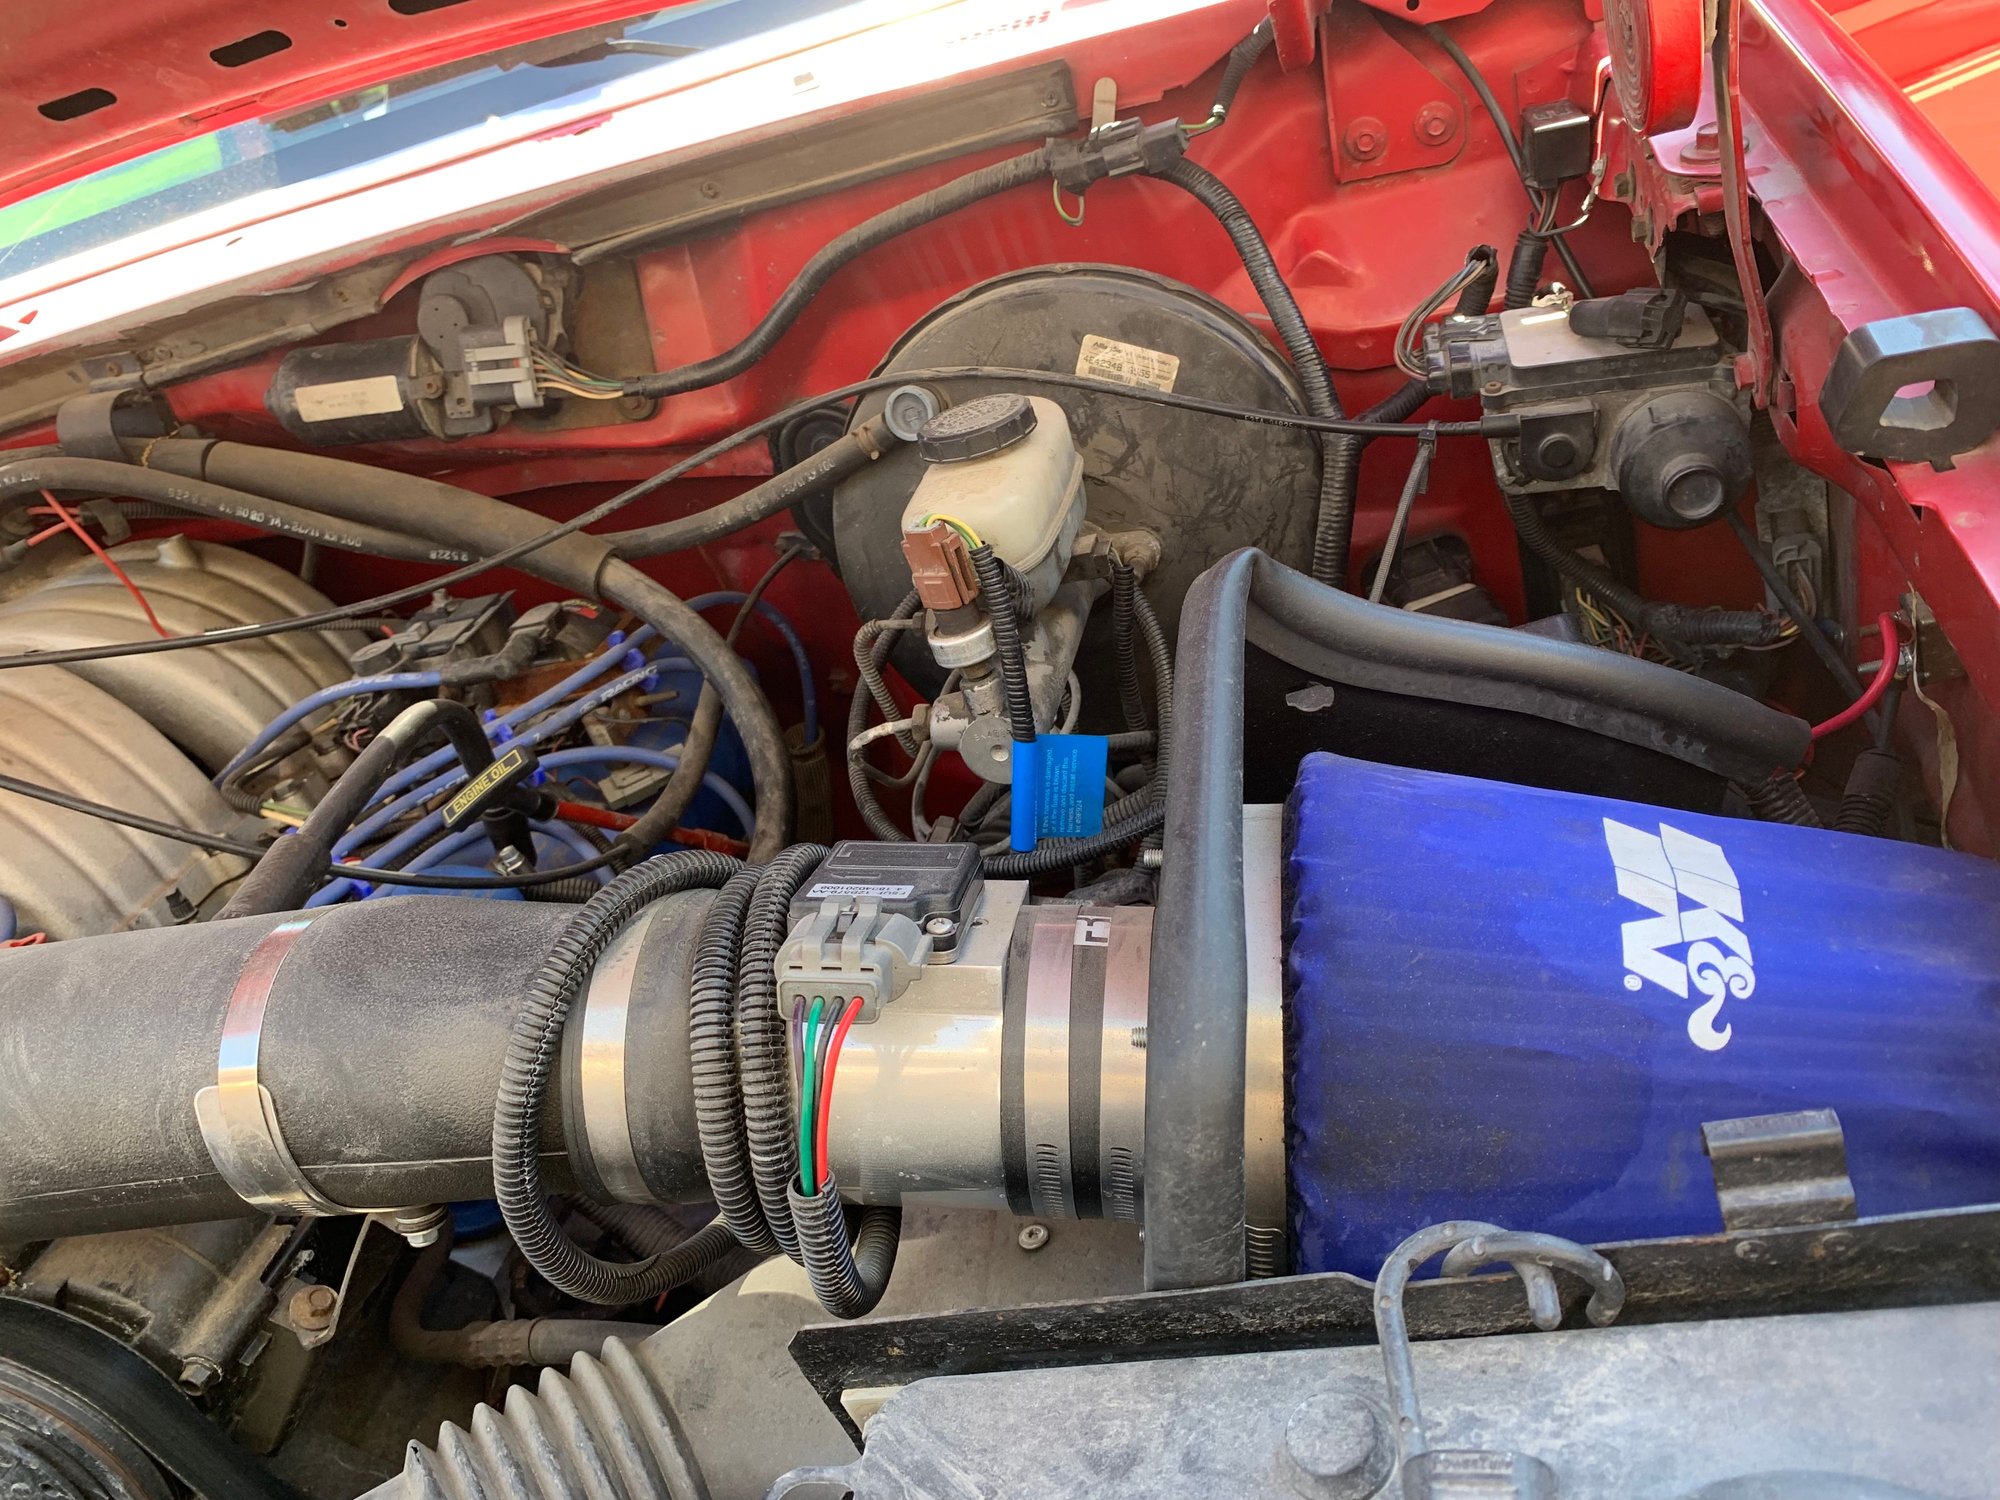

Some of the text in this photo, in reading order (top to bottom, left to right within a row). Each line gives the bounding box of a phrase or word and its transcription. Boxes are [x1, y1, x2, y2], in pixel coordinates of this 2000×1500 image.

[600, 665, 657, 702] RACING
[453, 762, 511, 813] ENGINE OIL
[1043, 788, 1051, 815] harness
[1067, 807, 1075, 833] harness
[1071, 749, 1079, 773] service
[1602, 817, 1756, 1051] K&N
